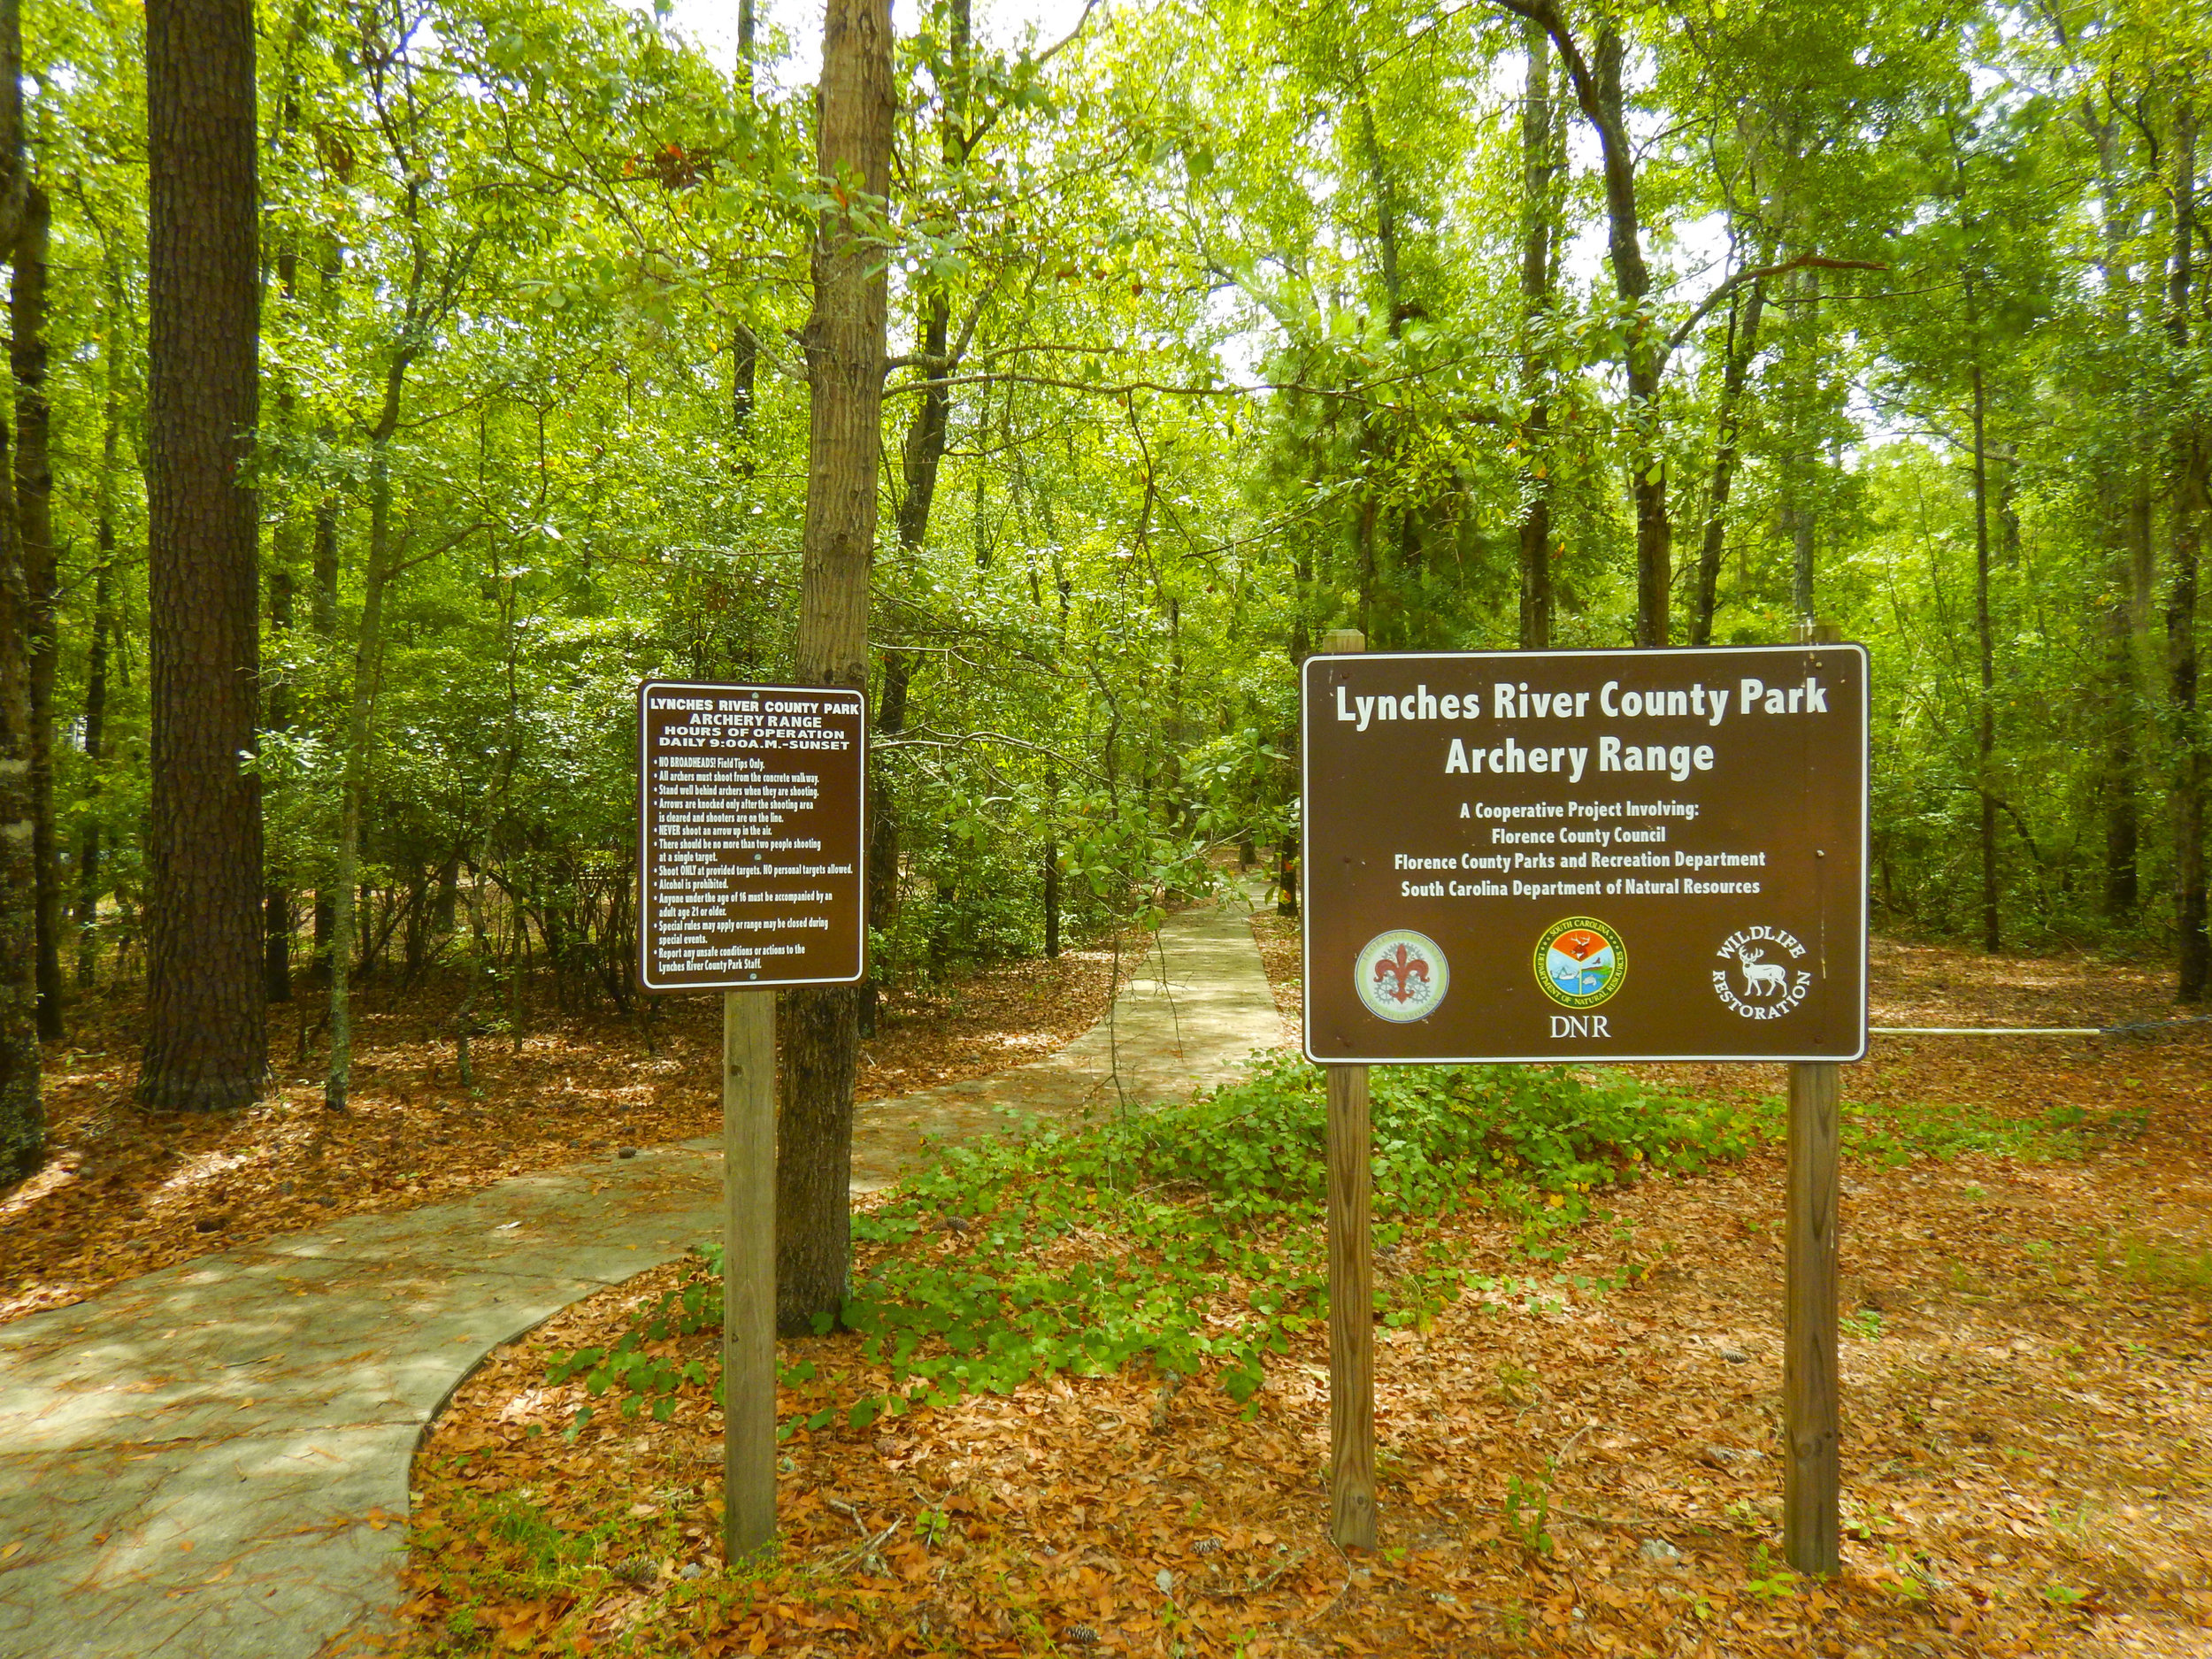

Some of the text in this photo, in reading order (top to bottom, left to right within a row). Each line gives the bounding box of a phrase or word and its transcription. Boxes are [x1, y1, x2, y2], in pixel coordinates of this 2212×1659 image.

[651, 698, 859, 715] LYNCHES RIVER COUNTY PARK
[1337, 678, 1827, 732] Lynches River County Park
[690, 713, 821, 727] ARCHERY RANGE
[664, 726, 721, 736] HOURS
[753, 729, 844, 739] OPERATION
[659, 737, 706, 747] DAILY
[659, 757, 764, 772] NO BROADHEADS! Field Tips Only.
[1445, 736, 1714, 783] Archery Range
[659, 771, 819, 786] All archers must shoot from the concrete walkway.
[659, 784, 678, 795] Stand
[680, 785, 694, 795] well
[695, 785, 717, 795] behind
[718, 785, 742, 795] archers
[744, 785, 761, 795] when
[763, 786, 777, 799] they
[790, 785, 818, 799] shooting.
[659, 798, 683, 809] Arrows
[697, 798, 724, 809] knocked
[726, 798, 740, 811] only
[741, 798, 757, 809] after
[758, 799, 769, 809] the
[770, 798, 798, 812] shooting
[1460, 801, 1699, 822] A Cooperative Project Involving:
[659, 812, 664, 822] is
[666, 812, 690, 822] cleared
[693, 812, 704, 822] and
[706, 812, 734, 822] shooters
[758, 812, 769, 822] the
[771, 812, 783, 822] line.
[659, 825, 680, 835] NEVER
[682, 825, 701, 835] shoot
[733, 828, 741, 838] up
[742, 825, 749, 835] in
[750, 825, 760, 835] the
[762, 826, 772, 835] air.
[1492, 826, 1665, 847] Florence County Council
[659, 838, 679, 849] There
[680, 838, 702, 849] should
[703, 839, 711, 849] be
[741, 839, 755, 849] than
[757, 840, 769, 849] two
[771, 838, 792, 851] people
[794, 838, 821, 851] shooting
[659, 852, 666, 862] at
[674, 852, 694, 864] single
[695, 852, 718, 864] target.
[1395, 851, 1765, 872] Florence County Parks and Recreation Department
[659, 864, 853, 878] Shoot ONLY at provided targets. NO personal targets allowed.
[659, 879, 728, 892] Alcohol is prohibited.
[1402, 879, 1760, 900] South Carolina Department of Natural Resources
[659, 893, 684, 907] Anyone
[685, 893, 705, 902] under
[706, 893, 716, 902] the
[718, 895, 729, 905] age
[731, 892, 738, 902] of
[740, 892, 746, 902] 16
[748, 893, 764, 902] must
[765, 892, 773, 901] be
[775, 891, 815, 903] accompanied
[816, 891, 824, 903] by
[659, 906, 676, 917] adult
[678, 909, 690, 919] age
[692, 906, 699, 917] 21
[709, 906, 726, 916] older.
[659, 920, 682, 933] Special
[684, 920, 701, 930] rules
[703, 922, 716, 933] may
[717, 919, 734, 933] apply
[744, 921, 762, 932] range
[764, 921, 776, 931] may
[778, 918, 786, 928] be
[787, 918, 807, 927] closed
[809, 918, 828, 930] during
[1549, 919, 1610, 937] SOUTH CAROLINA
[659, 933, 707, 946] special events.
[1717, 926, 1807, 959] WILDLIFE
[659, 948, 681, 960] Report
[683, 949, 695, 961] any
[696, 946, 718, 956] unsafe
[719, 946, 753, 956] conditions
[763, 944, 785, 955] actions
[787, 945, 794, 954] to
[795, 944, 805, 954] the
[659, 959, 761, 974] Lynches River County Park Staff.
[1537, 951, 1624, 1006] DEPARTMENT OF NATURAL RESOURCES
[1713, 970, 1811, 1019] RESTORATION
[1550, 1015, 1611, 1038] DNR
